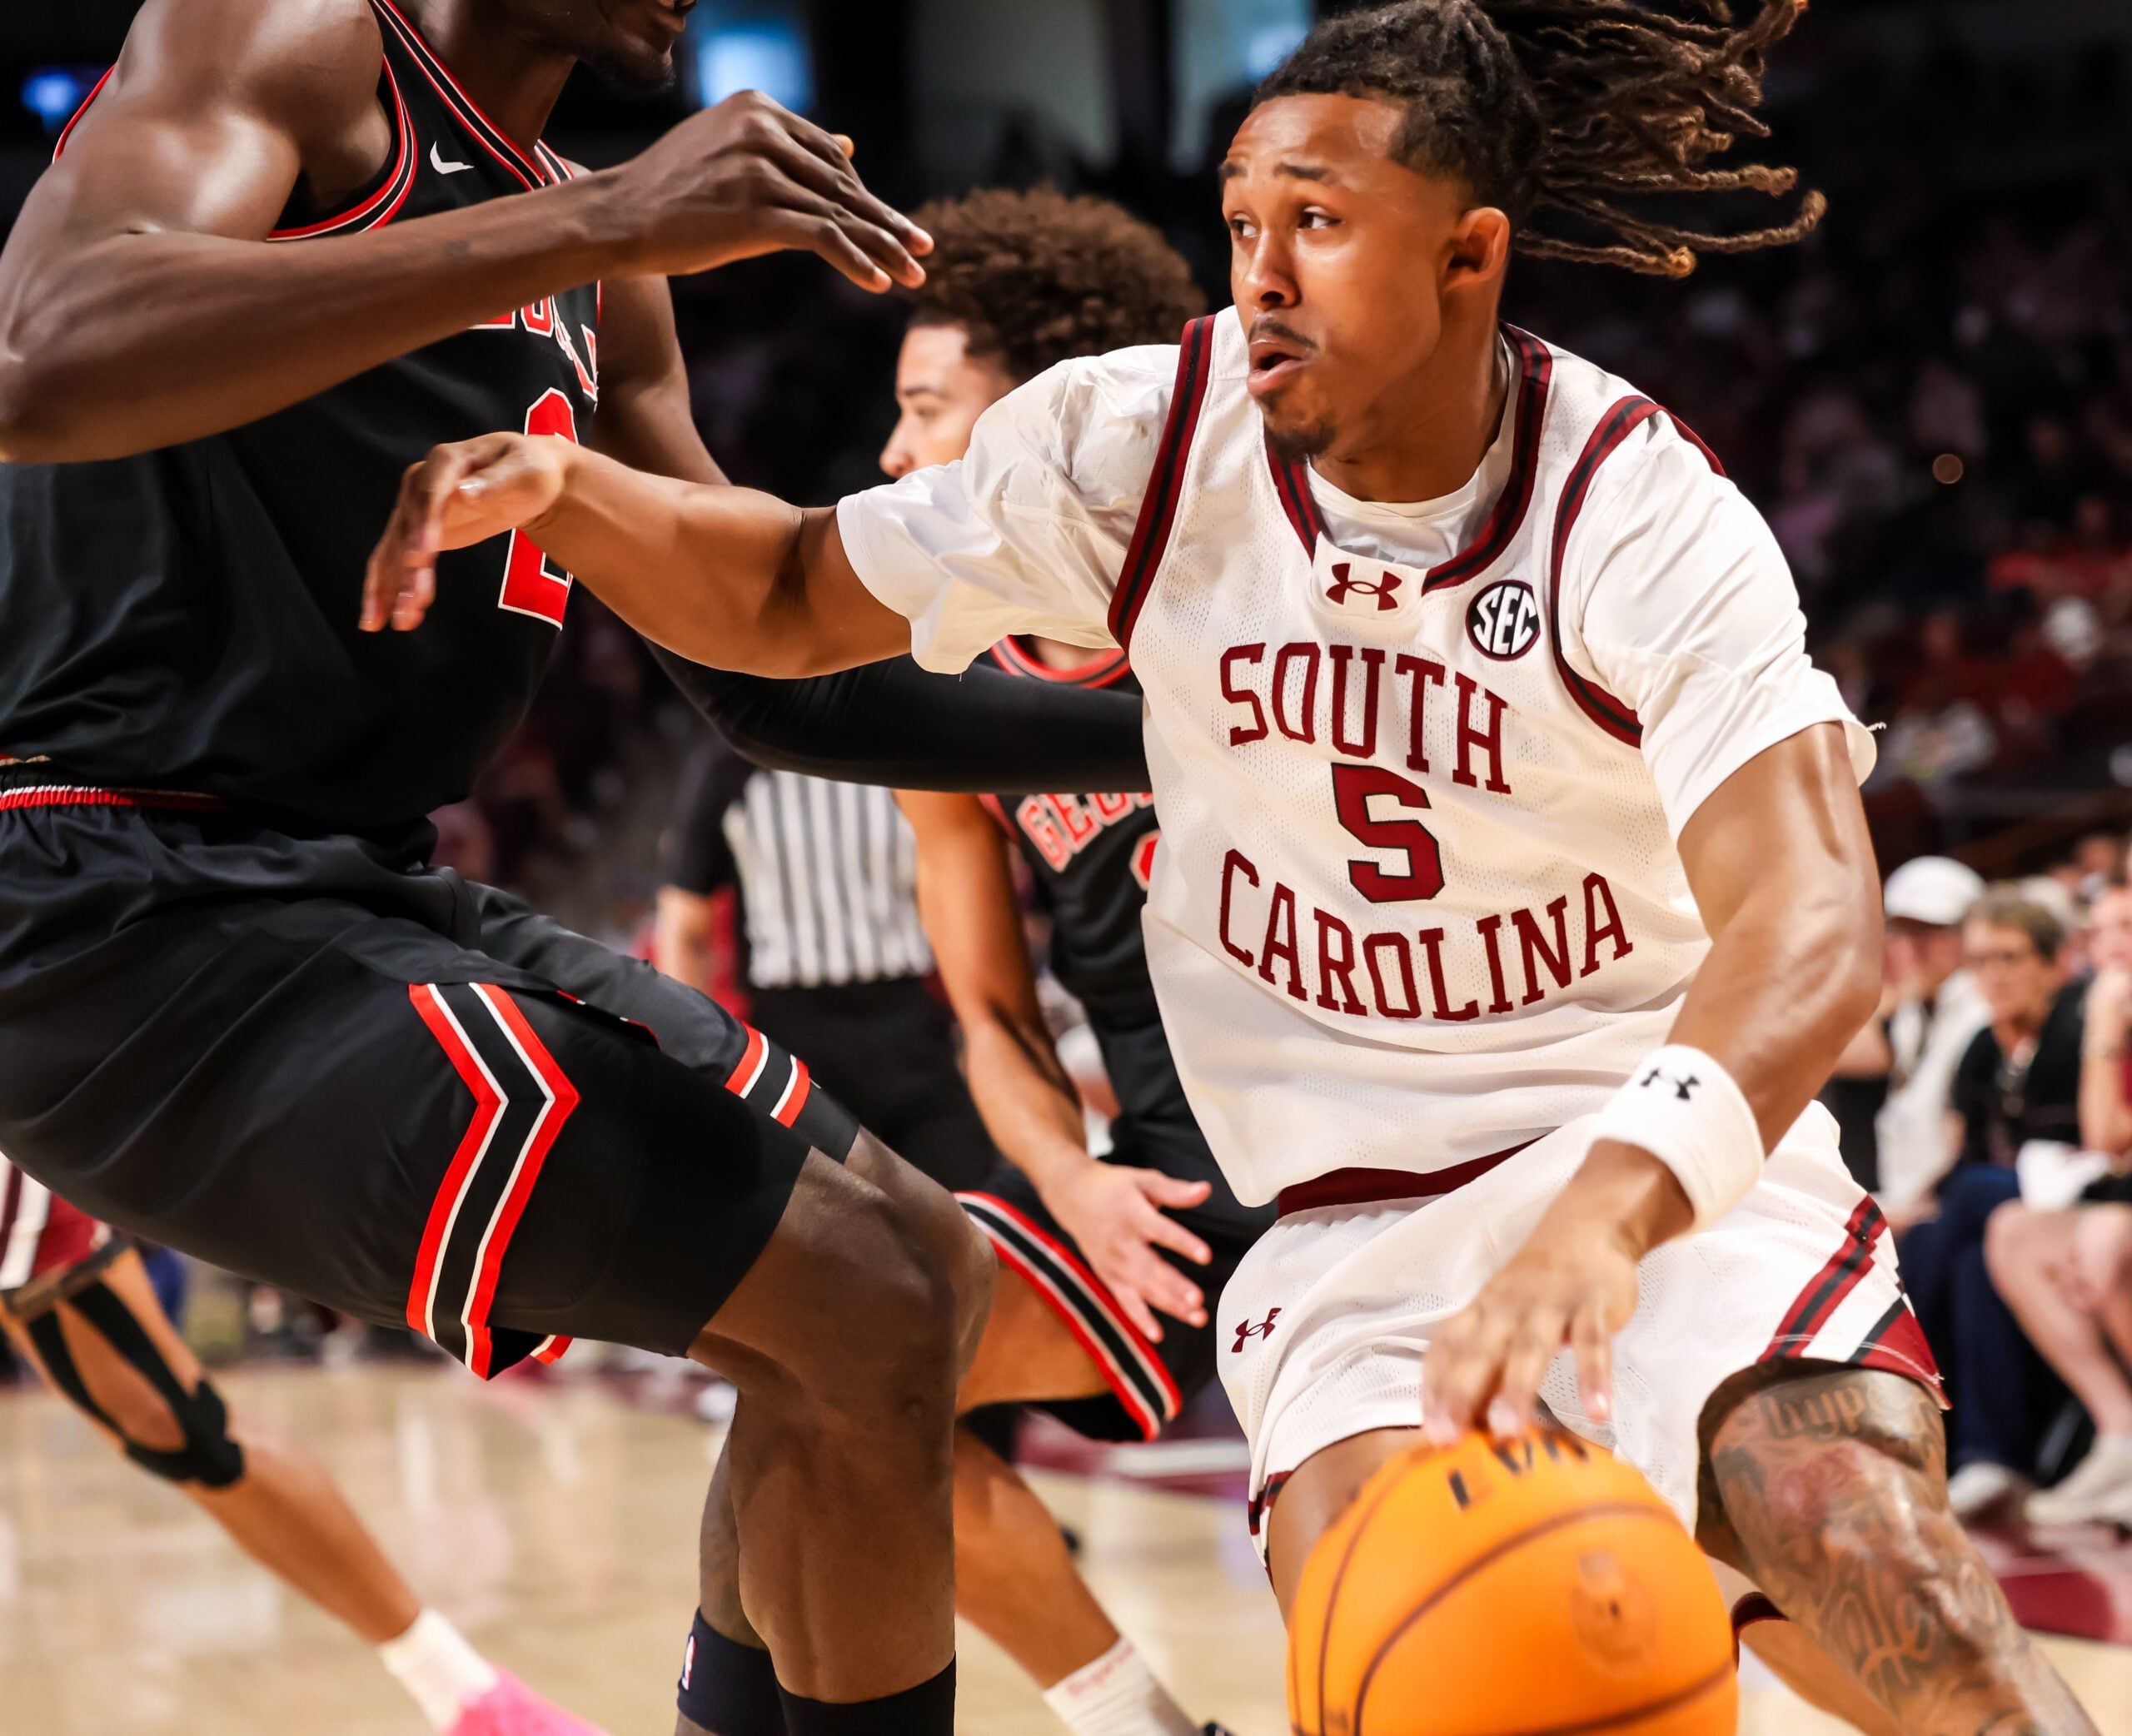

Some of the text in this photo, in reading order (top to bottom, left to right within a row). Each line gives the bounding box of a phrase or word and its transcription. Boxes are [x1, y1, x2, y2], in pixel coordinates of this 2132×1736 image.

[1472, 584, 1537, 655] SEC
[1219, 641, 1512, 794] SOUTH
[1330, 762, 1445, 903] 5
[1218, 848, 1634, 1022] CAROLINA
